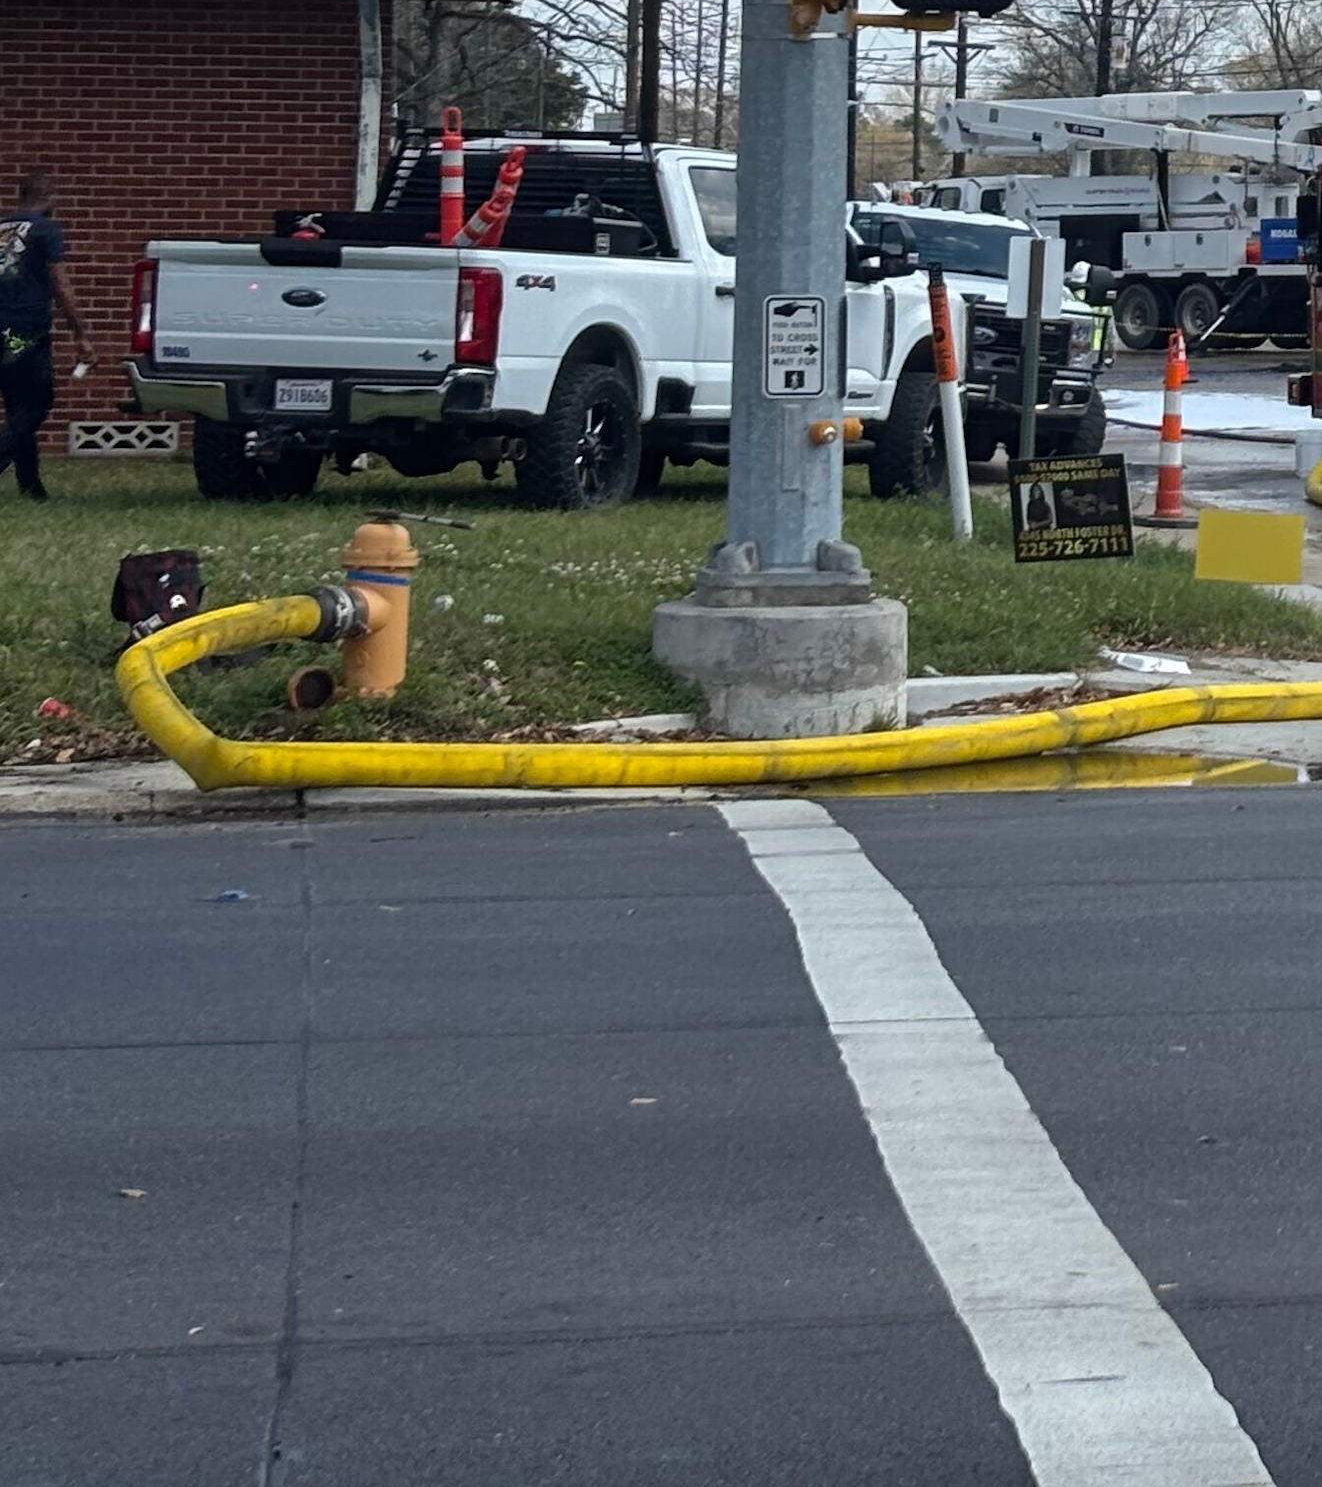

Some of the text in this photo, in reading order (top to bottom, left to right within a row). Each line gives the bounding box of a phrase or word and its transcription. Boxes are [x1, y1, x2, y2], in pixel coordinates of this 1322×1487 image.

[772, 333, 818, 342] TO CROSS
[770, 345, 803, 354] STREET
[773, 357, 817, 366] WAIT FOR
[1029, 457, 1103, 472] TAX ADVANCES
[1071, 468, 1099, 481] SAME
[1100, 466, 1121, 479] DAY
[1042, 526, 1073, 539] NORTH
[1075, 524, 1109, 538] FOSTER
[1019, 536, 1129, 557] 225-726-7111
